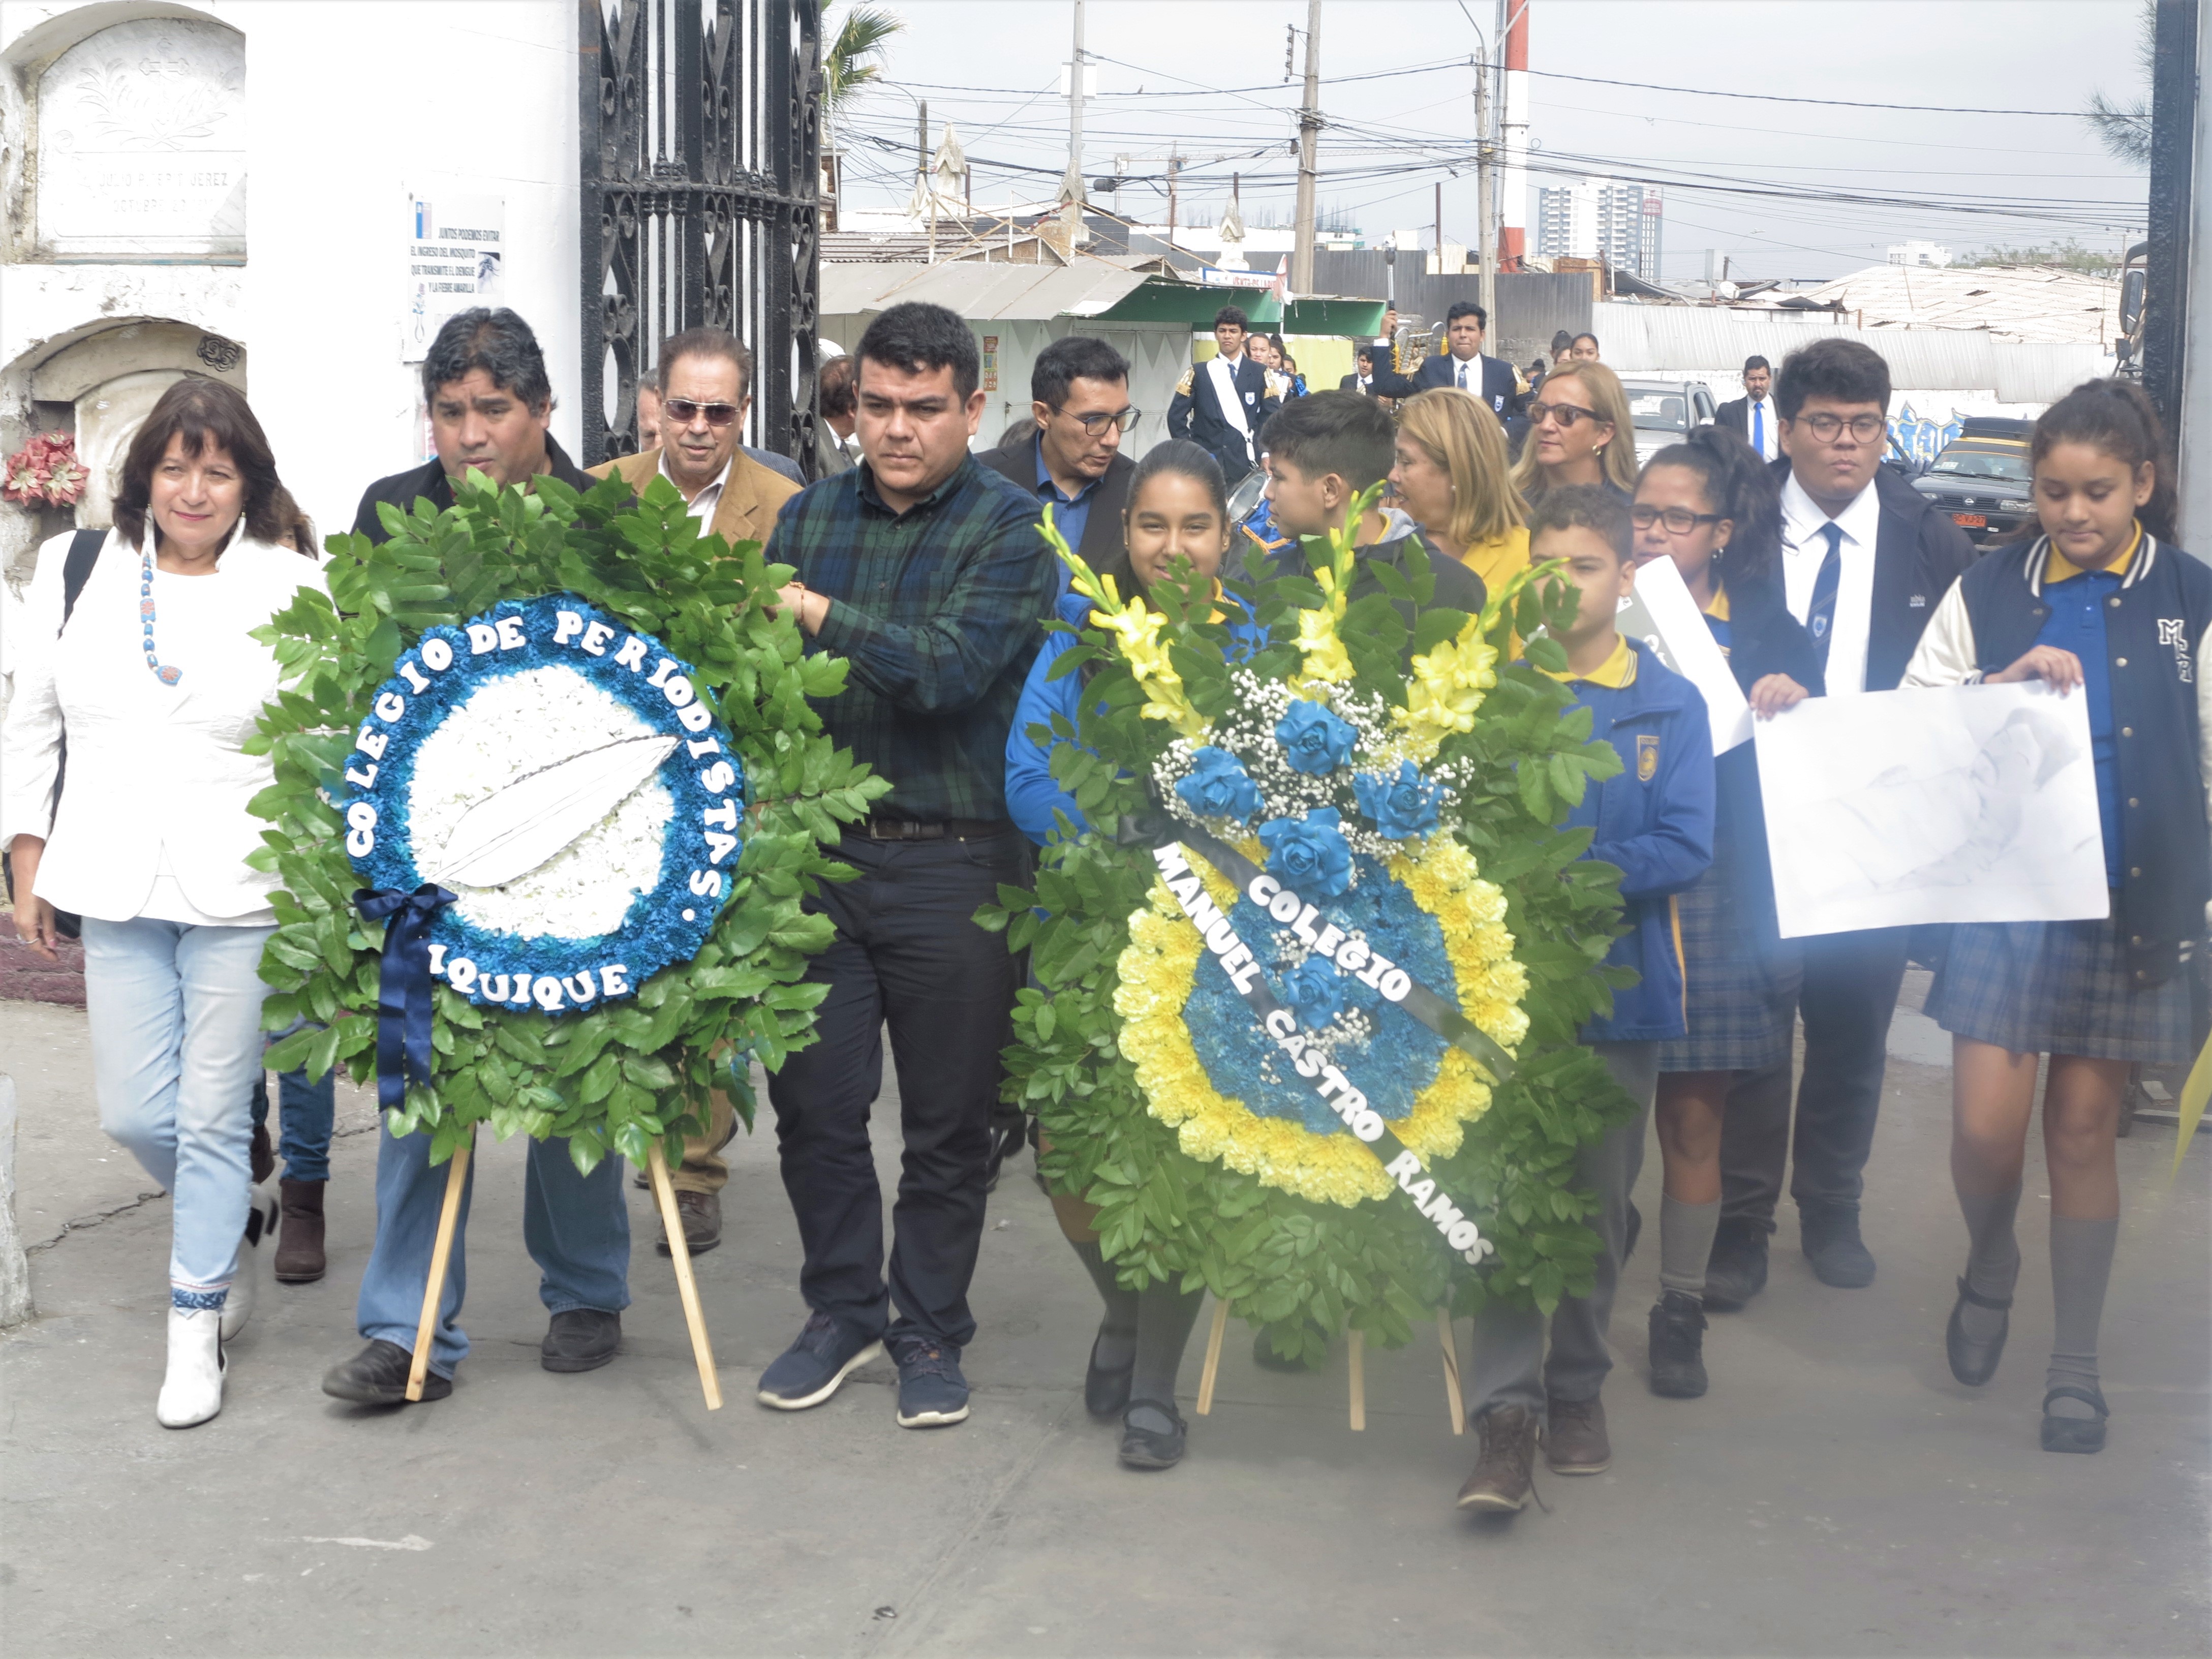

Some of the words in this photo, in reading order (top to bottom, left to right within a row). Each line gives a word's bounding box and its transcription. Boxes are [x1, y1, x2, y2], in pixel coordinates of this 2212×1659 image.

[190, 172, 229, 187] JEREZ
[438, 227, 457, 239] JUNTOS
[457, 228, 482, 241] PODEMOS
[482, 229, 500, 242] EVITAR
[410, 245, 417, 256] EL
[417, 246, 439, 257] INGRESO
[439, 247, 449, 258] DEL
[449, 247, 476, 260] MOSQUITO
[411, 264, 421, 276] QUE
[421, 264, 448, 276] TRANSMITE
[448, 265, 455, 276] EL
[455, 265, 475, 276] DENGUE
[432, 282, 438, 293] LA
[438, 282, 453, 293] FIEBRE
[453, 283, 475, 293] AMARILLA
[346, 637, 453, 858] COLEGIO
[465, 616, 526, 655] DE
[1248, 874, 1412, 1002] COLEGIO
[427, 944, 629, 1011] IQUIQUE
[1152, 841, 1265, 995] MANUEL
[1266, 1009, 1385, 1143] CASTRO
[1385, 1149, 1494, 1265] RAMOS
